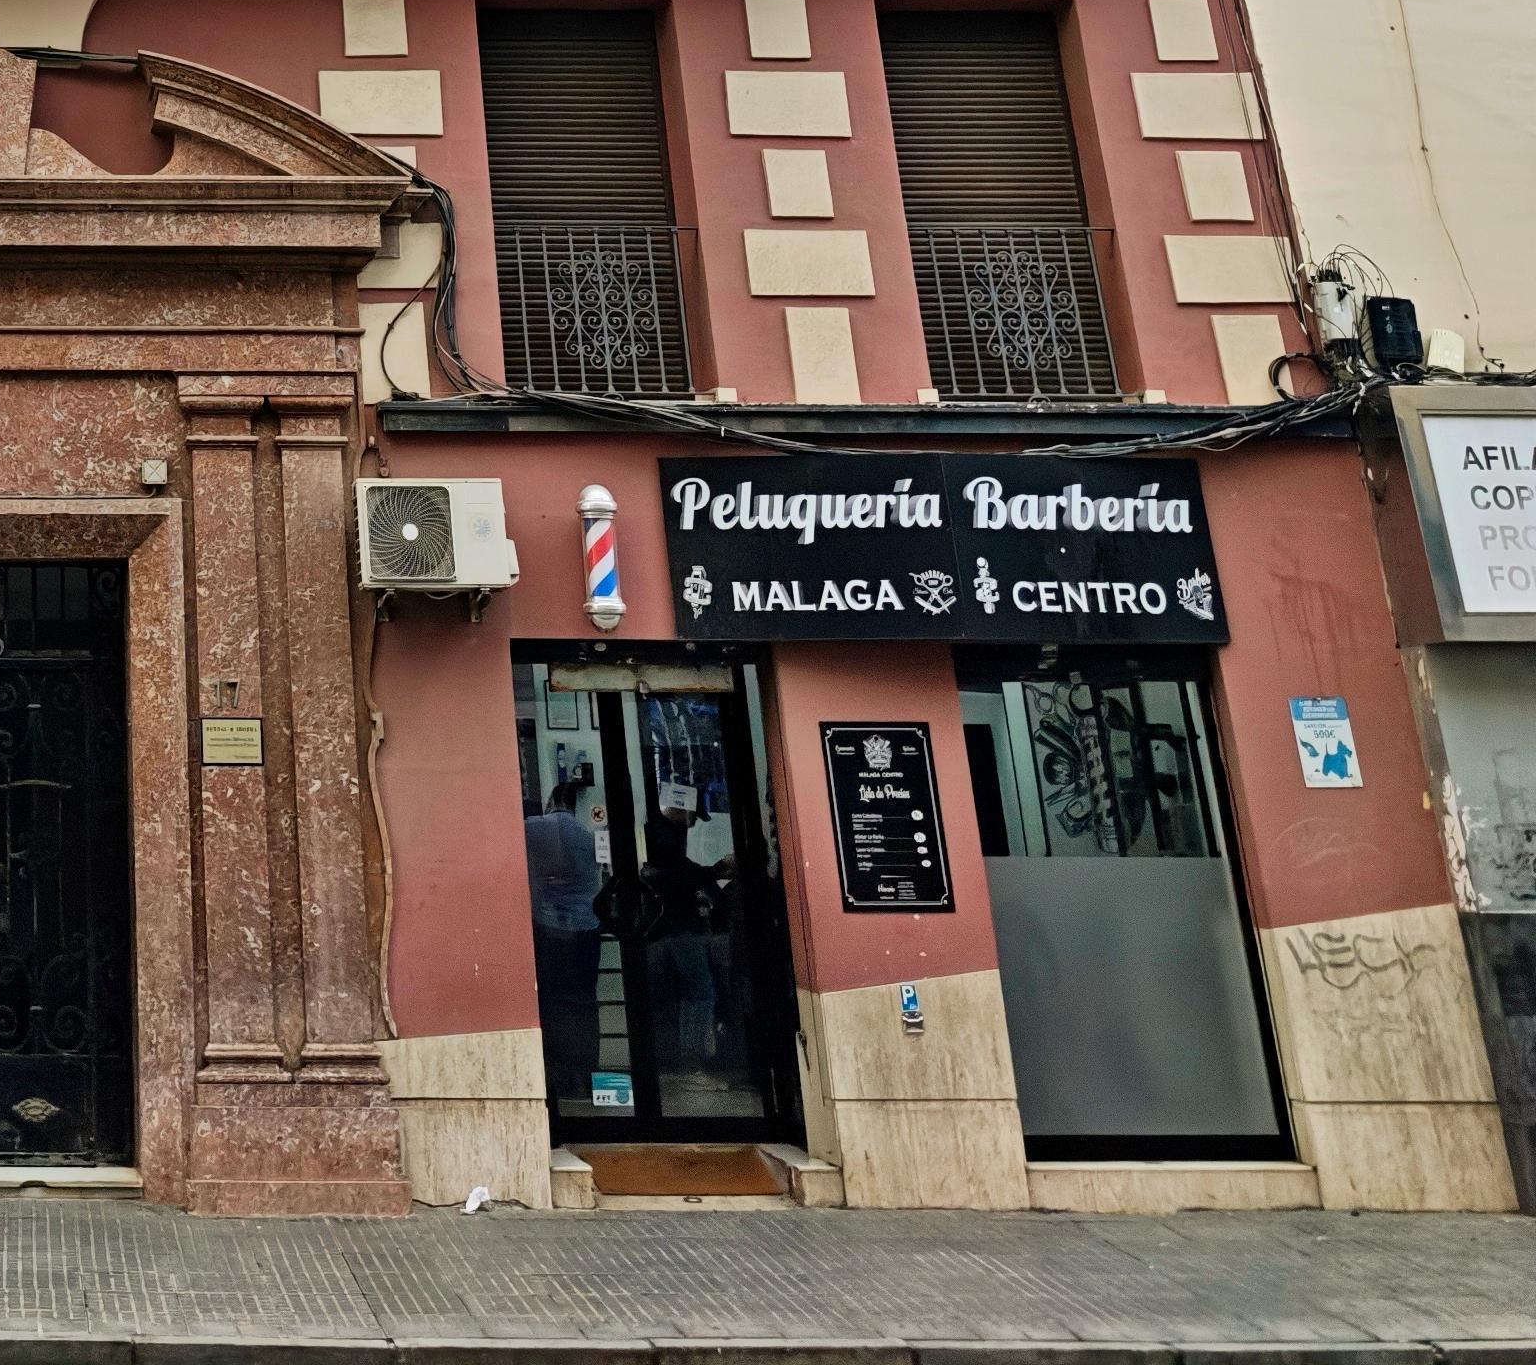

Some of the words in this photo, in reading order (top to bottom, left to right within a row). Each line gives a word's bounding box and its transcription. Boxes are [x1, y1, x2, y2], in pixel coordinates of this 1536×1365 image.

[1463, 445, 1536, 470] AFIL
[669, 477, 943, 545] Peluquería
[962, 476, 1194, 534] Barbería
[1487, 565, 1536, 592] FO
[731, 579, 906, 612] MALAGA
[1012, 580, 1166, 615] CENTRO
